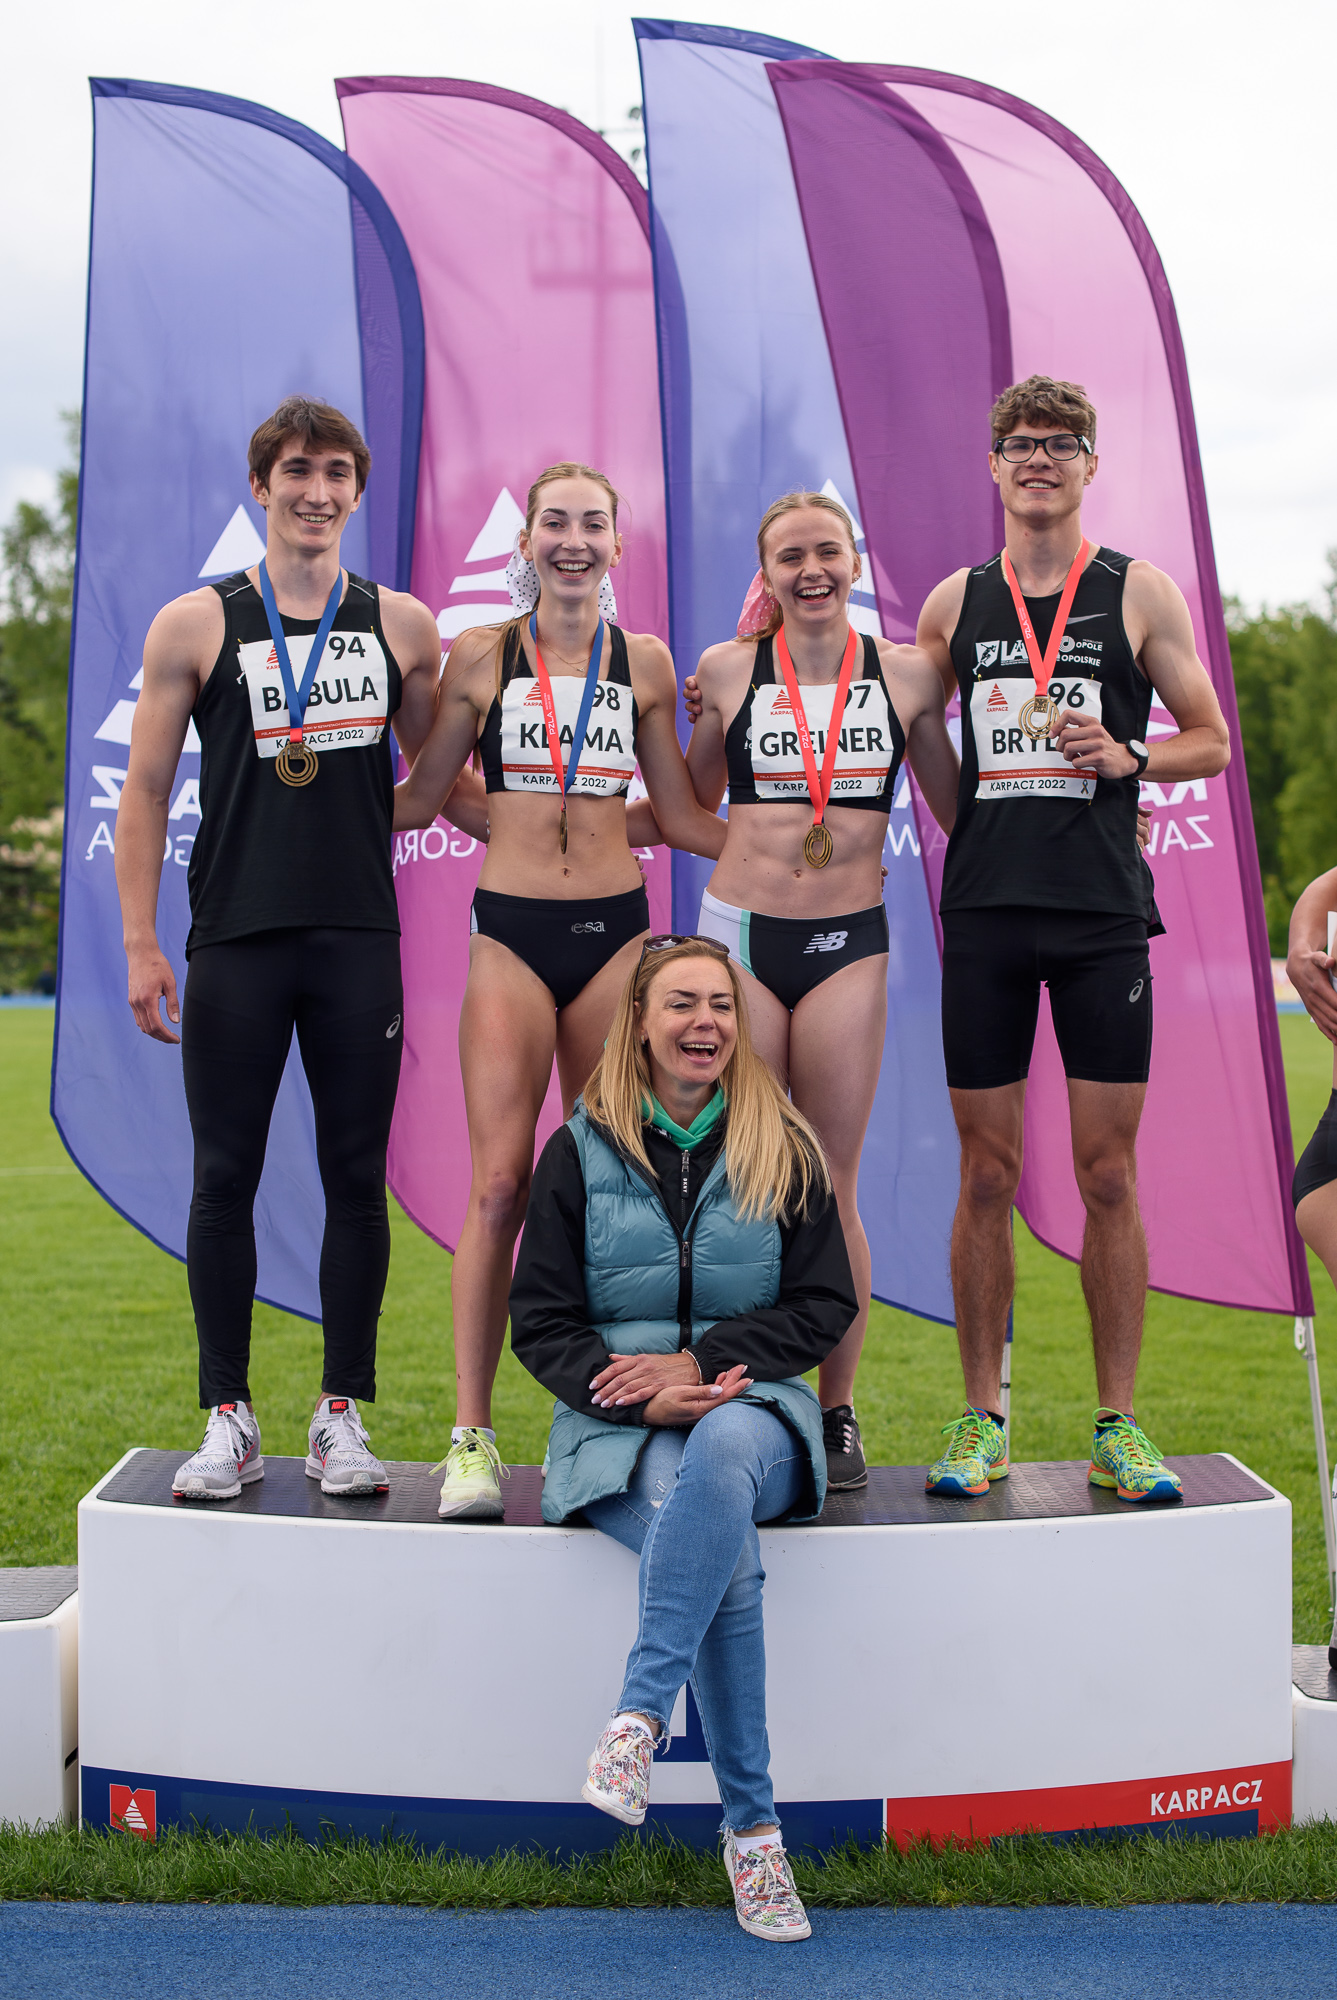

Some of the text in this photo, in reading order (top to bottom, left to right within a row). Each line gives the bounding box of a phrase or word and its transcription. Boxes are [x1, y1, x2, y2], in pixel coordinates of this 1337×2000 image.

[328, 636, 366, 661] 94
[1075, 641, 1103, 652] OPOLE
[1060, 654, 1101, 667] OPOLSKIE
[262, 676, 379, 713] BBULA
[592, 684, 621, 711] 98
[844, 684, 872, 709] 7
[1048, 682, 1085, 708] 96
[546, 711, 556, 735] PZLA
[275, 729, 364, 749] KAPACZ 2022
[520, 723, 624, 754] KLAMA
[800, 725, 810, 749] PZLA
[522, 774, 607, 789] KARPAZ 2022
[774, 779, 863, 792] KARP 2022
[989, 778, 1067, 792] KARPACZ 2022
[1150, 1779, 1264, 1816] KARPACZ
